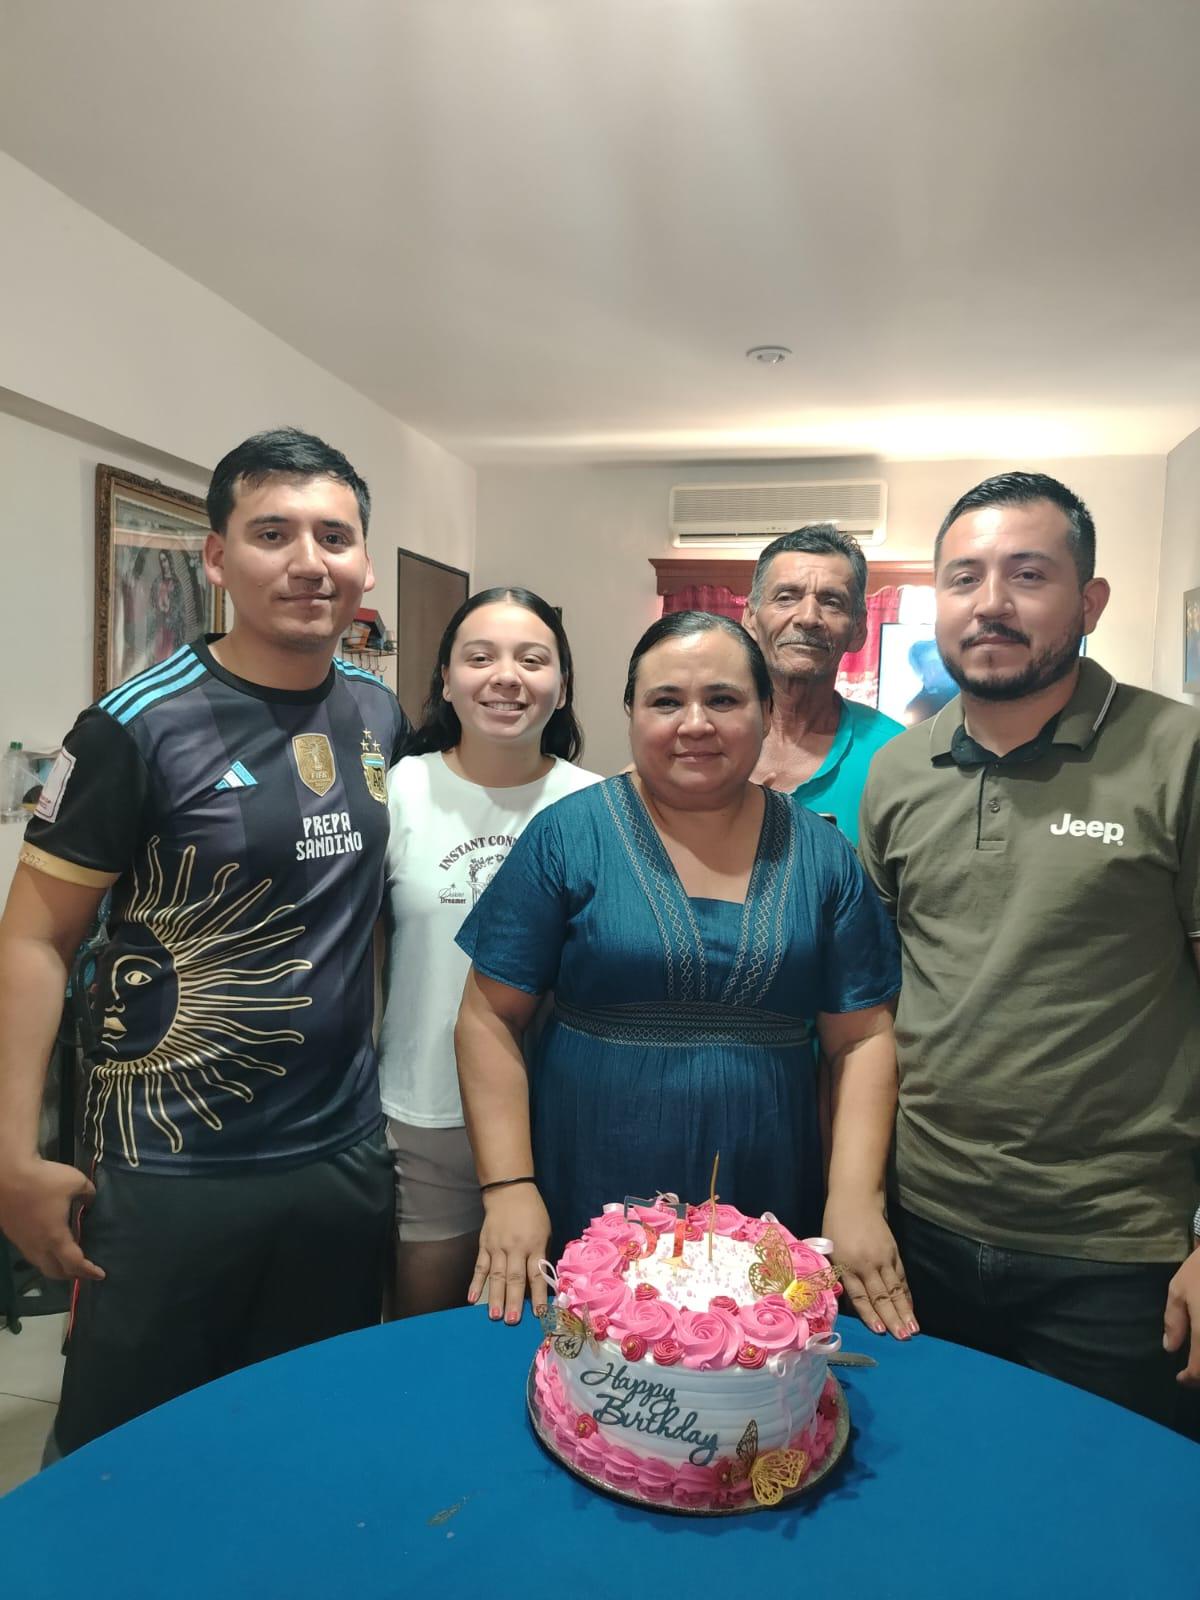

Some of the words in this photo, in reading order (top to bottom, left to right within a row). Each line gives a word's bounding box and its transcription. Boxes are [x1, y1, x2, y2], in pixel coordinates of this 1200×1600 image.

[302, 812, 351, 838] PREPA
[1050, 813, 1124, 844] Jeep
[296, 831, 363, 861] SANDINO
[439, 836, 485, 871] INSTANT
[488, 834, 518, 848] CON
[580, 1362, 676, 1415] Happy
[592, 1393, 719, 1467] Birthday
